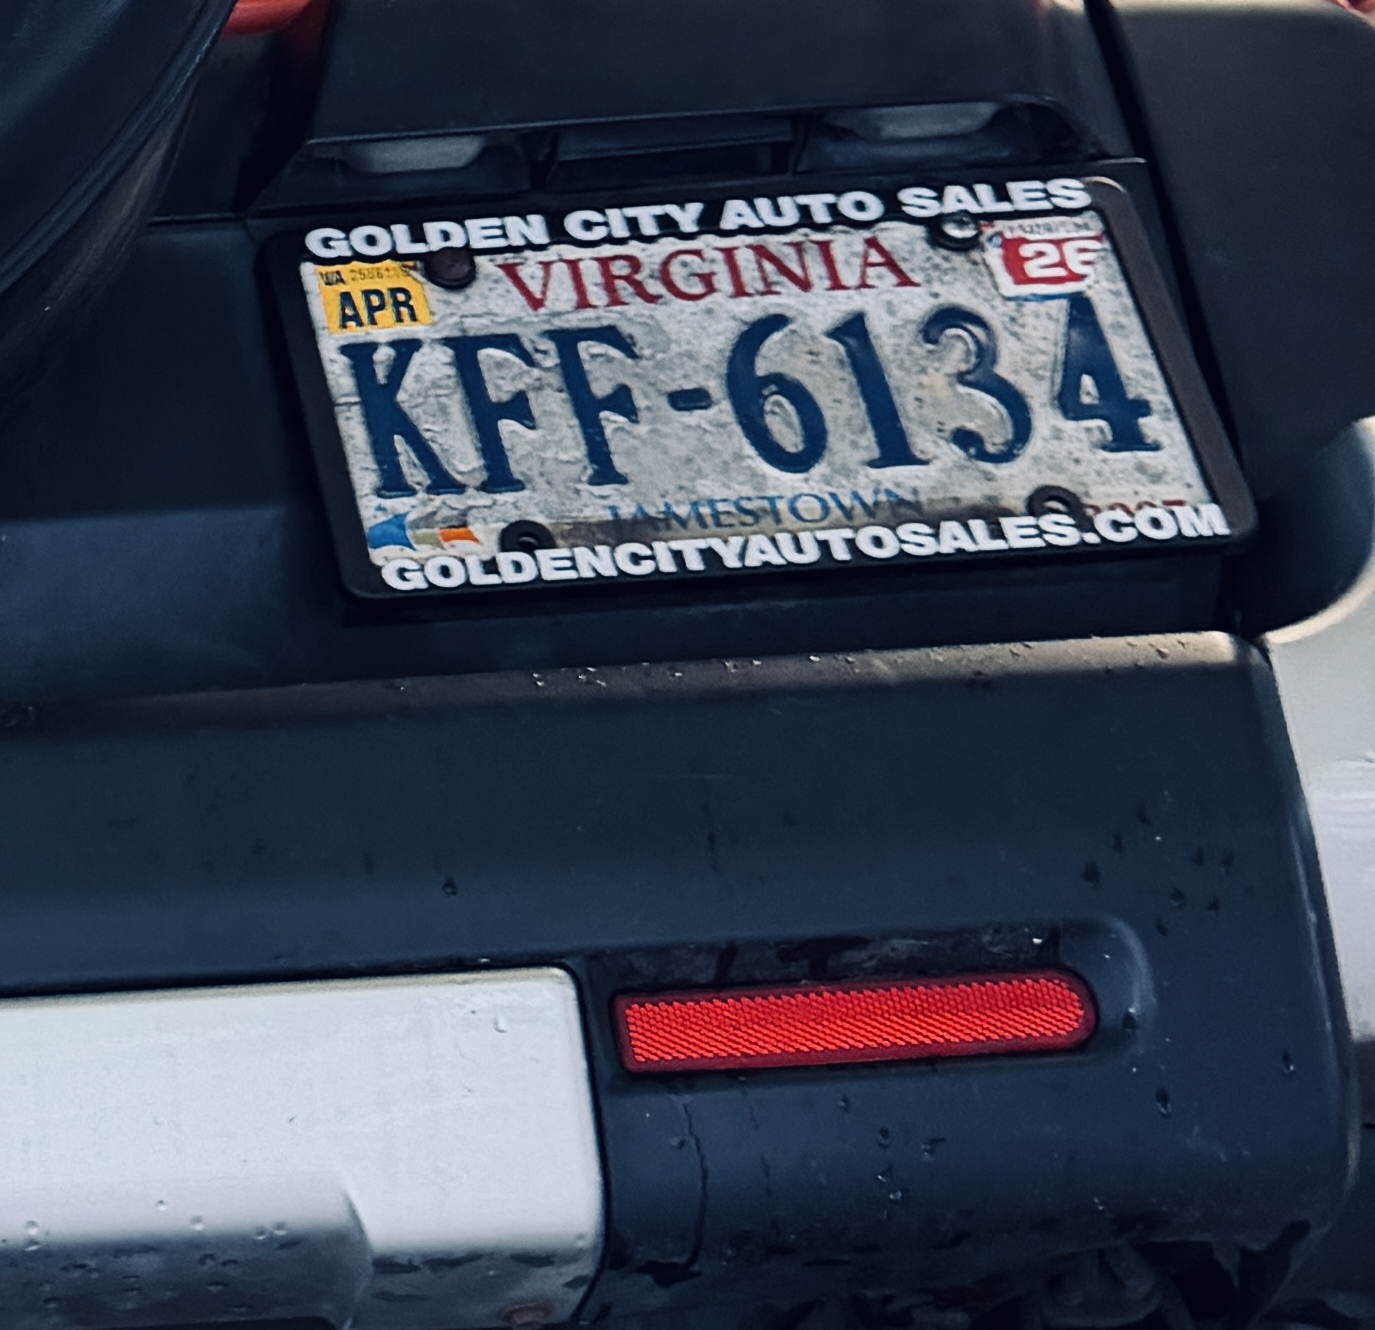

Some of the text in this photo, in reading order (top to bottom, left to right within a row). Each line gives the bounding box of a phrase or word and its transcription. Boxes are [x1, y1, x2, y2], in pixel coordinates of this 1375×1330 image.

[305, 178, 1093, 258] GOLDEN CITY AUTO SALES
[339, 287, 417, 330] APR
[495, 240, 922, 314] VIRGINIA
[339, 291, 1161, 499] KFF-6134
[381, 503, 1231, 591] GOLDENCITYAUTOSALES.COM
